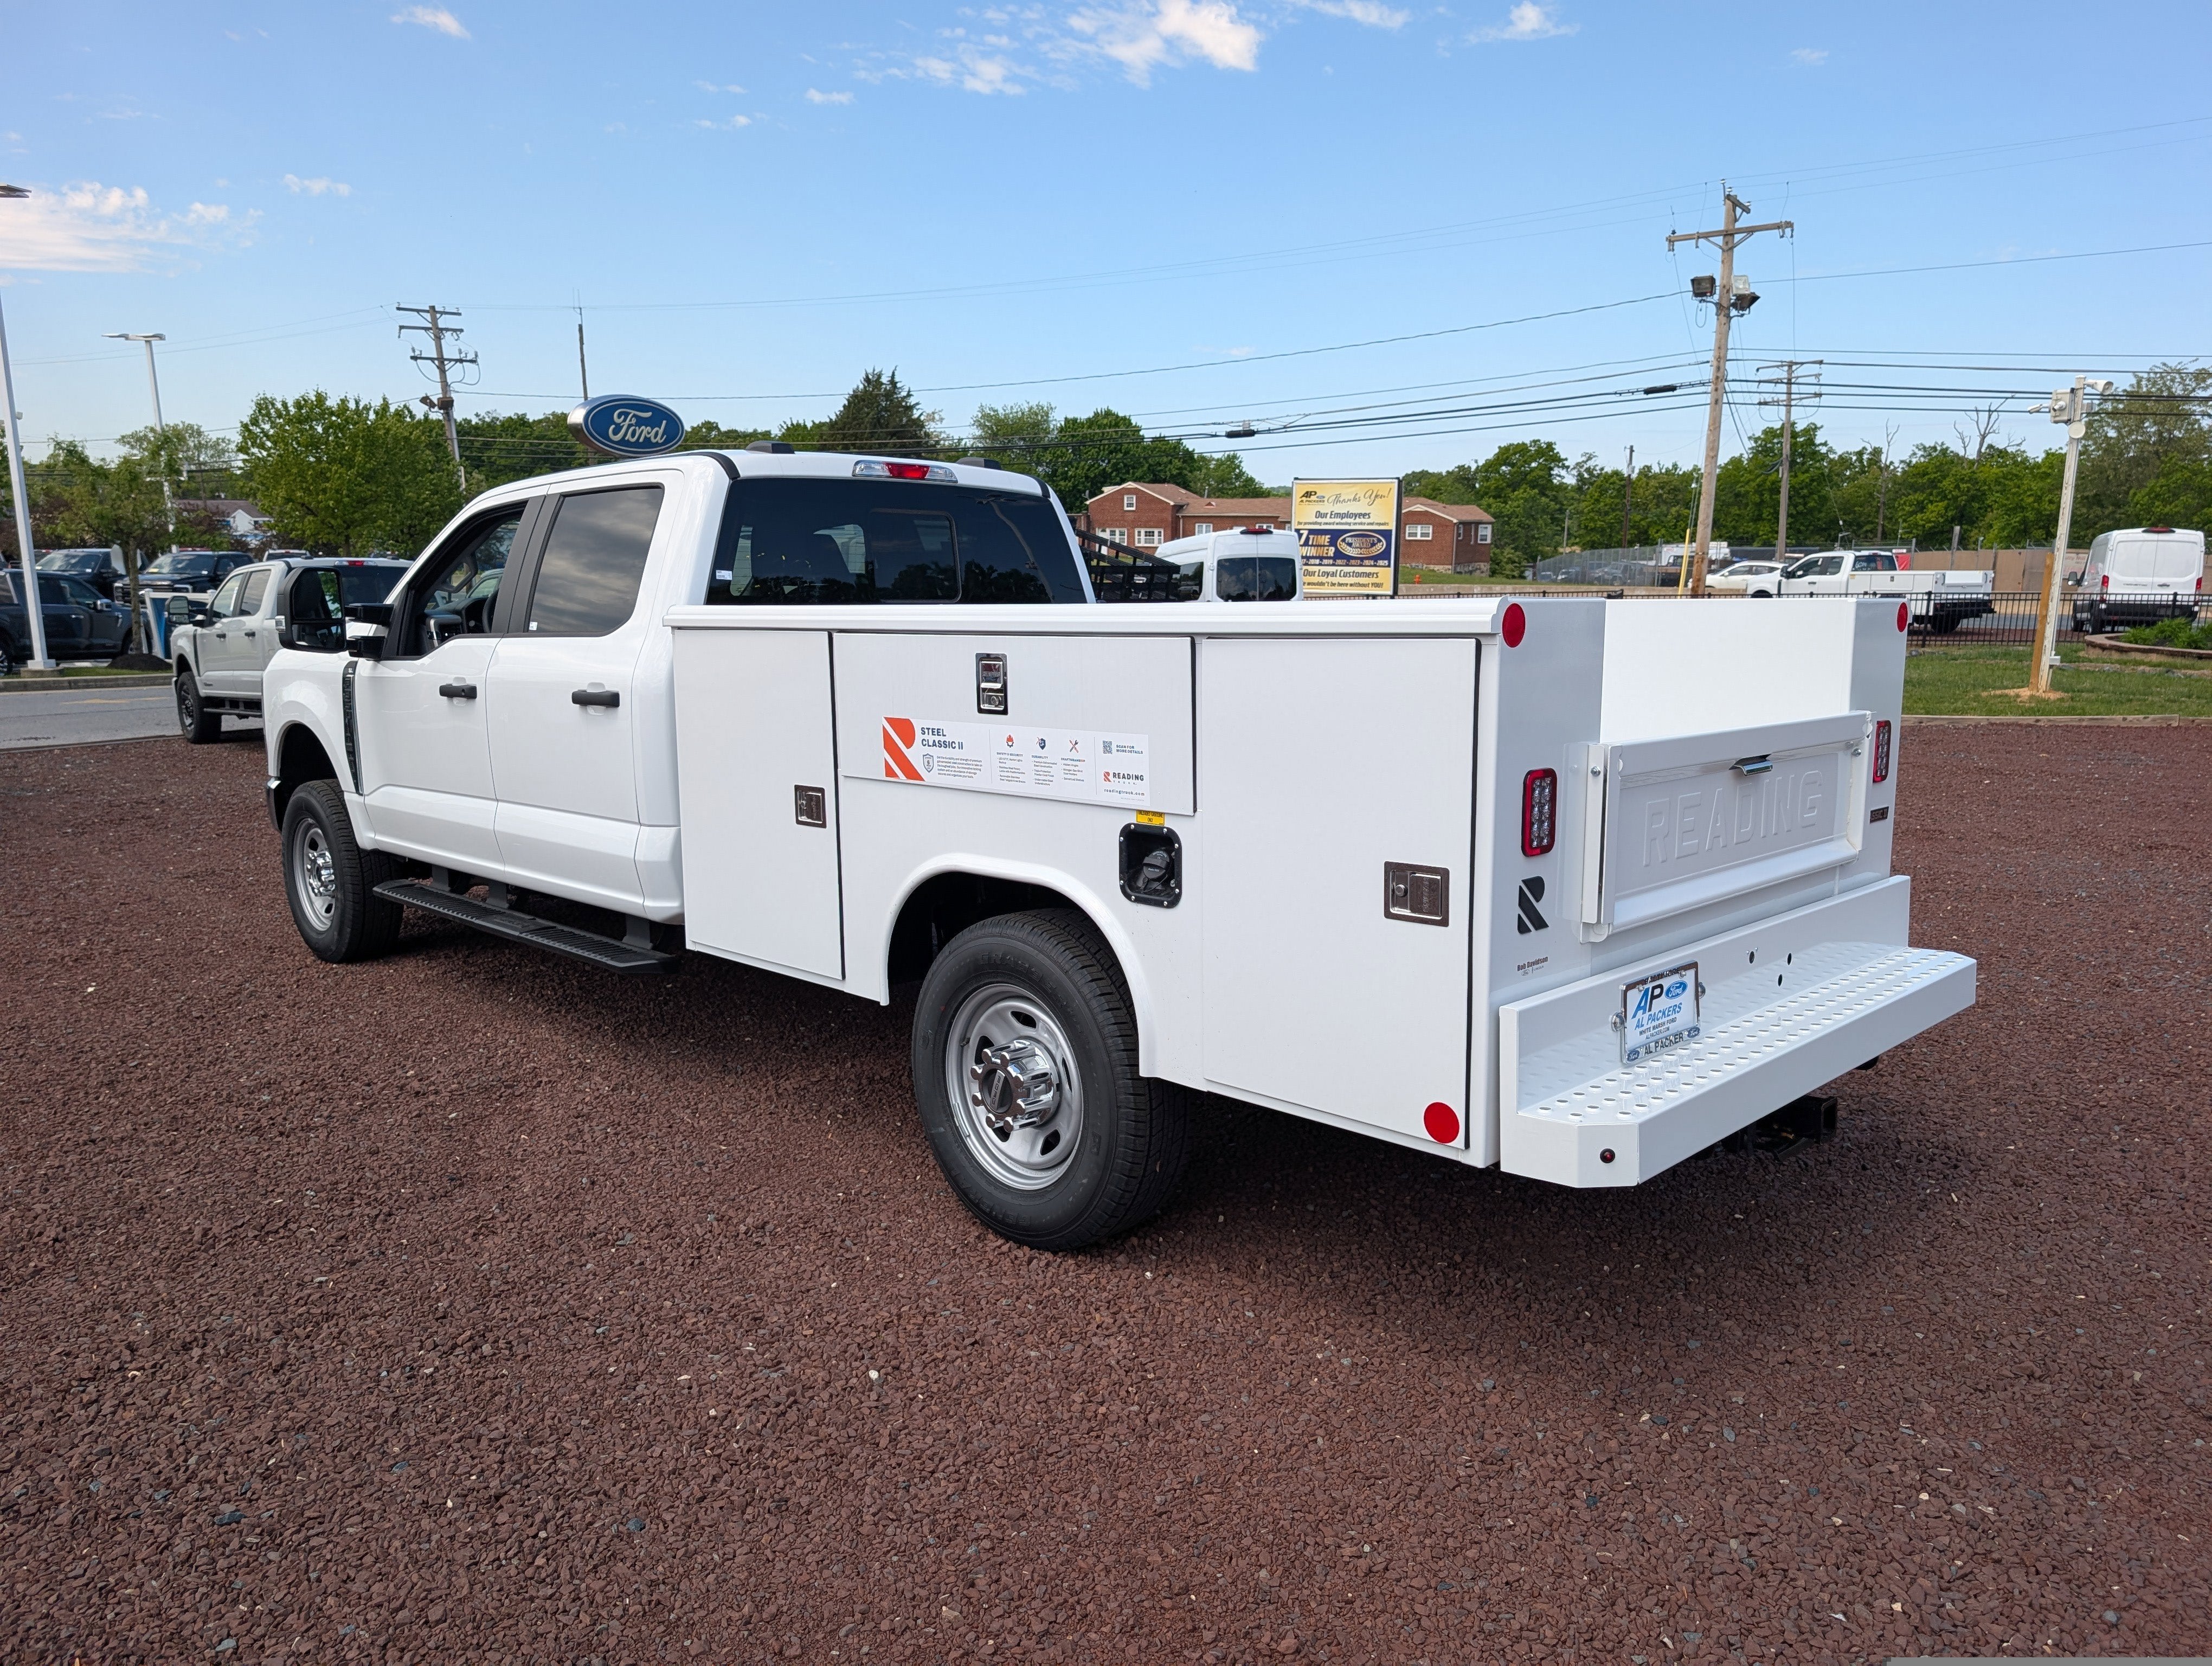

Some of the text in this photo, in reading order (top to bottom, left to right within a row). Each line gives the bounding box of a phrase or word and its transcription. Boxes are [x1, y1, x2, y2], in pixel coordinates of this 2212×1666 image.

[608, 408, 667, 444] Ford
[1299, 490, 1317, 498] AP
[1327, 493, 1361, 506] Thanks
[1315, 510, 1371, 521] Our Employees
[1299, 529, 1332, 546] 7 TIME
[1299, 546, 1335, 557] WINNER
[1303, 568, 1379, 579] Our Loyal Customers
[921, 727, 947, 737] STEEL
[921, 738, 963, 750] CLASSIC II
[1113, 772, 1144, 781] READING
[1643, 770, 1823, 868] READING
[1517, 956, 1548, 971] Bob Davidson
[1668, 983, 1684, 997] Ford
[1631, 983, 1664, 1020] AP
[1634, 1002, 1683, 1030] AL PACKERS
[1639, 1016, 1677, 1036] WHITE MARSH FORD
[1645, 1026, 1670, 1040] ALPACKER.COM
[1644, 1032, 1684, 1056] AL PACKER
[992, 1075, 1001, 1105] FORD
